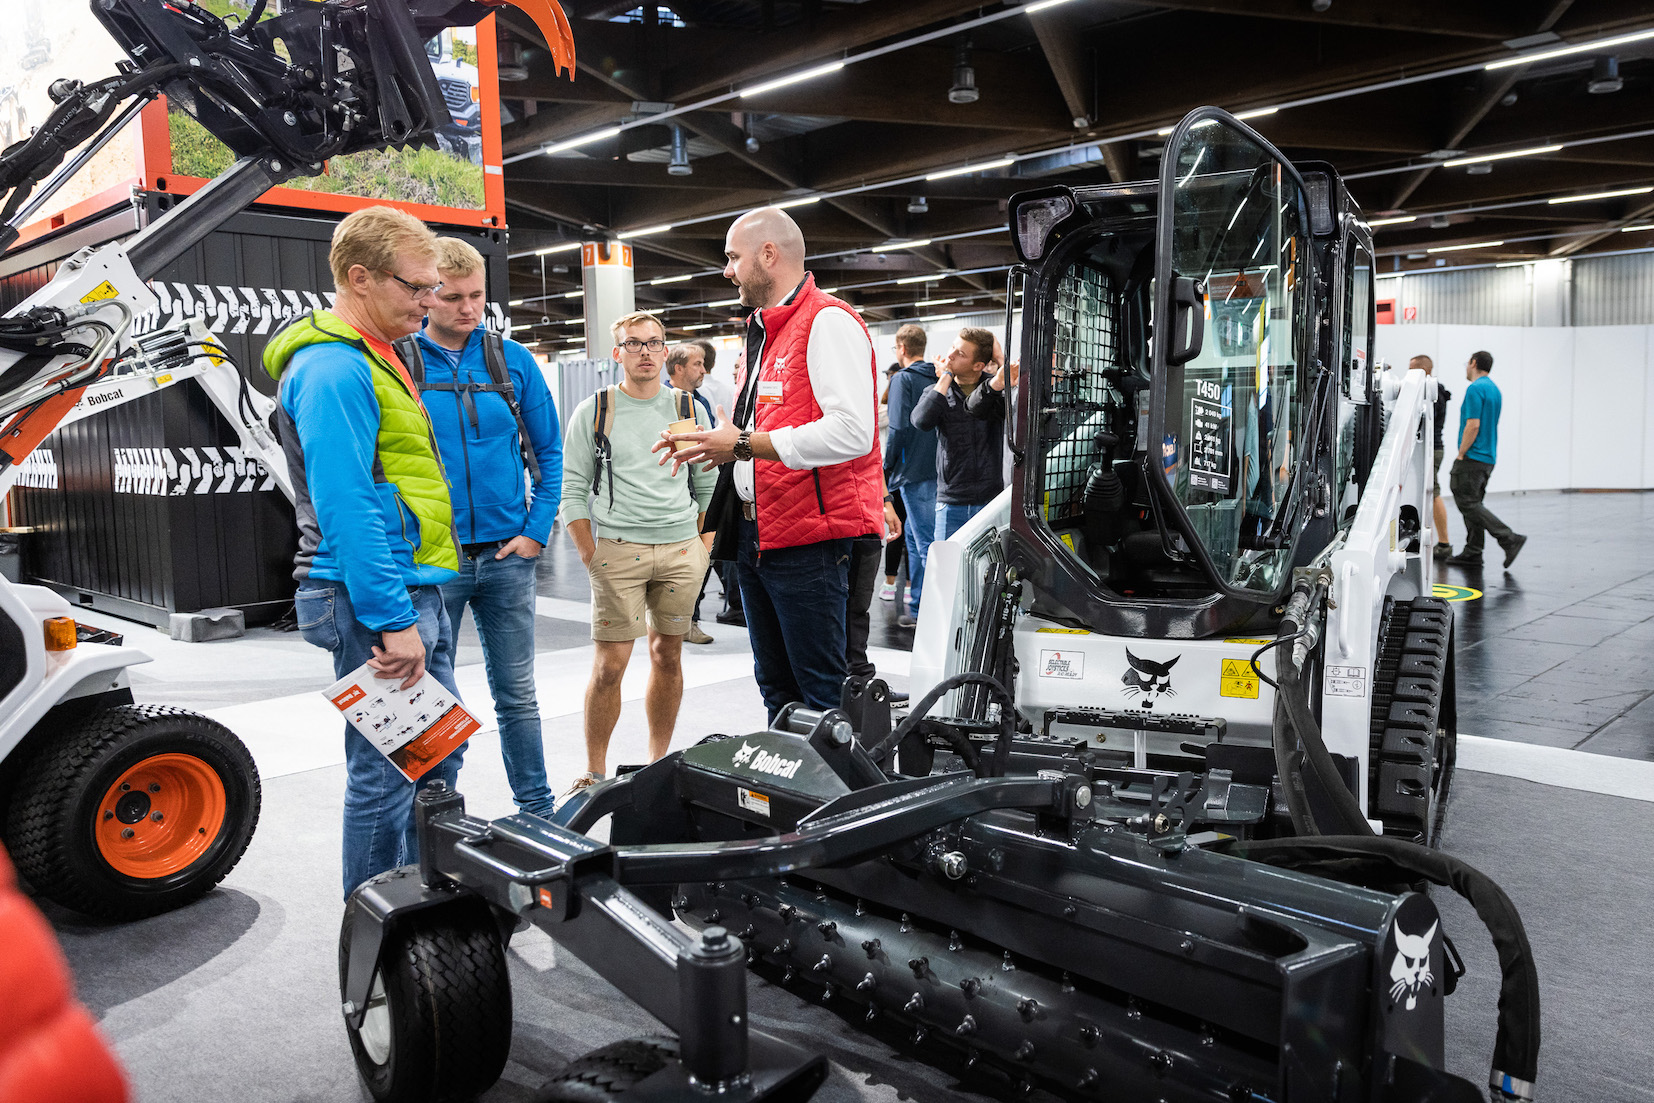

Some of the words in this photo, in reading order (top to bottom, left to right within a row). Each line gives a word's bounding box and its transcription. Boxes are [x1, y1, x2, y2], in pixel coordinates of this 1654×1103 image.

[586, 248, 591, 263] 7
[624, 249, 629, 264] 7
[87, 388, 124, 406] Bobcat
[1195, 379, 1220, 400] T450
[749, 750, 803, 779] Bobcat
